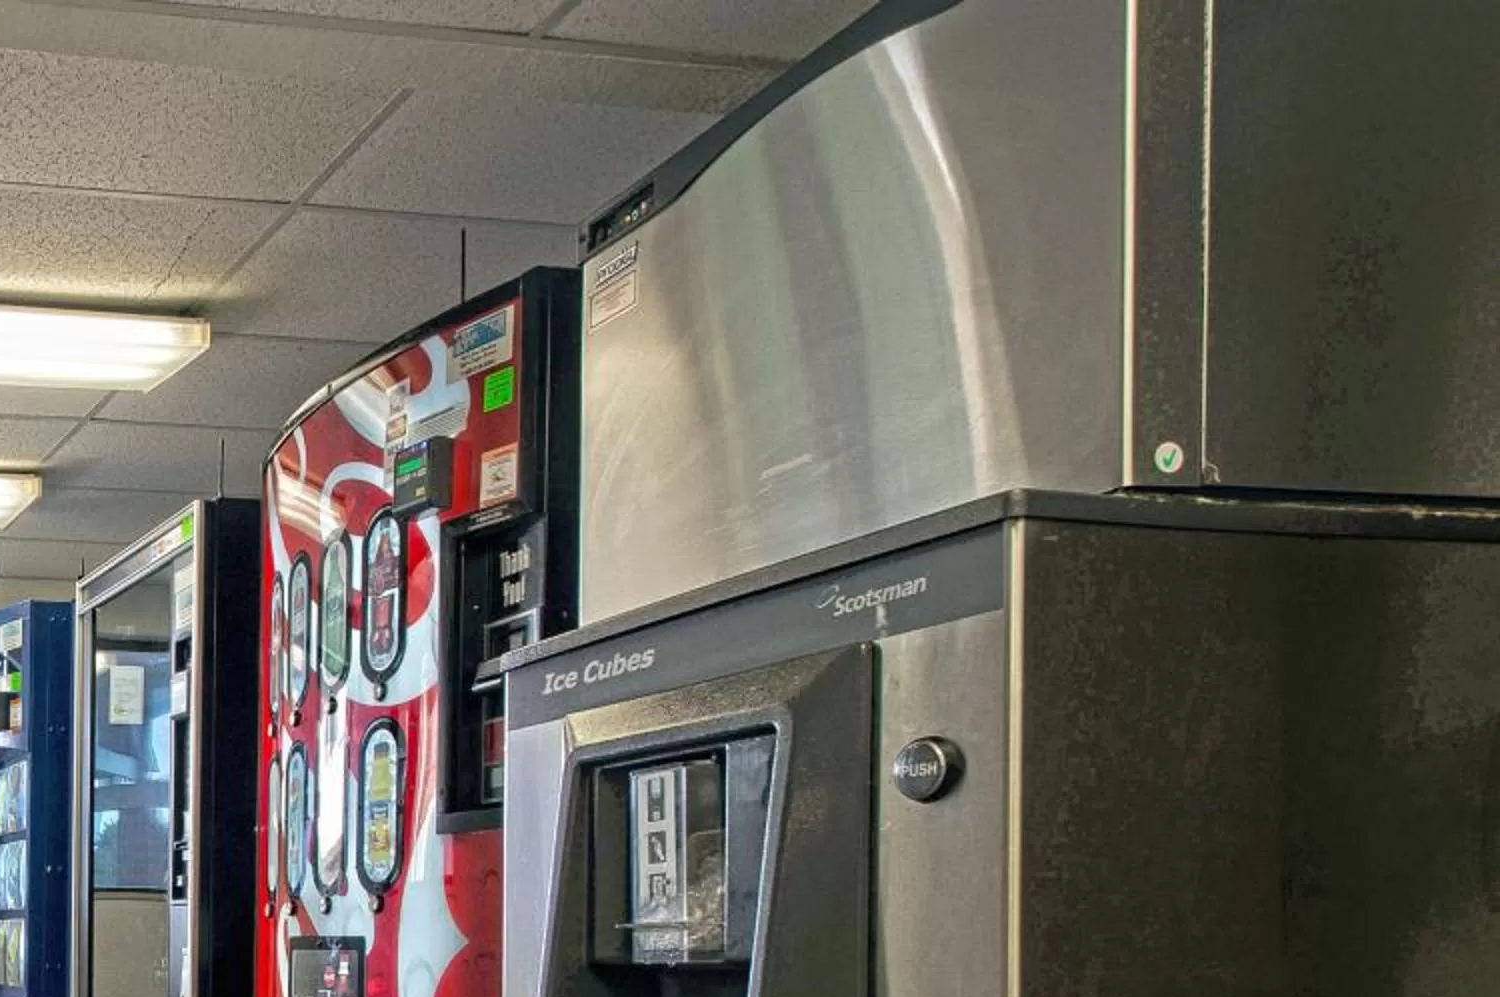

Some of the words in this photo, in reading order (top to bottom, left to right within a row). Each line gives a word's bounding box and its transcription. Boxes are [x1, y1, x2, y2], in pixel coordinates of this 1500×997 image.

[833, 576, 927, 617] Scotsman
[541, 671, 579, 695] Ice
[583, 648, 656, 683] Cubes
[899, 761, 938, 778] PUSH
